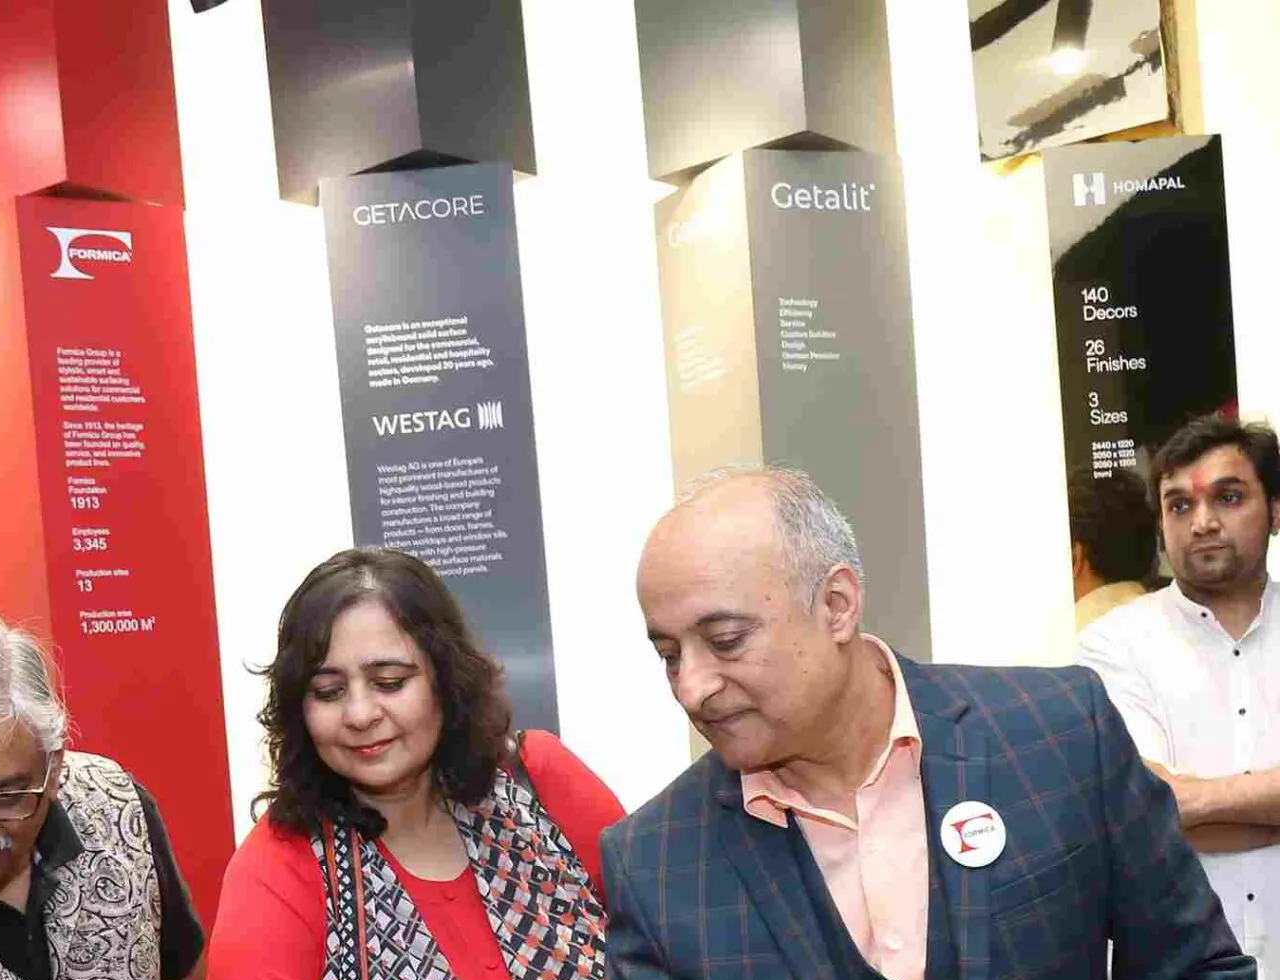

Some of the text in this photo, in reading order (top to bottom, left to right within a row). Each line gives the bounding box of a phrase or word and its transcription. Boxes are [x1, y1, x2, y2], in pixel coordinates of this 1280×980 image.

[1113, 177, 1186, 194] HOMAPAL
[352, 195, 485, 226] GETACORE
[69, 248, 132, 263] FORMICA
[1081, 286, 1109, 304] 140
[1083, 305, 1138, 321] Decors
[1085, 339, 1105, 356] 26
[1087, 355, 1147, 373] Finishes
[1089, 391, 1099, 408] 3
[372, 407, 472, 436] WESTAG
[1091, 408, 1128, 425] Sizes
[376, 463, 407, 474] Westag
[408, 461, 420, 470] AG
[71, 496, 100, 509] 1913
[72, 528, 110, 537] Employees
[73, 538, 108, 552] 3,345
[76, 569, 112, 578] Production
[78, 579, 93, 592] 13
[80, 611, 116, 619] Production
[81, 618, 138, 635] 1,300,000
